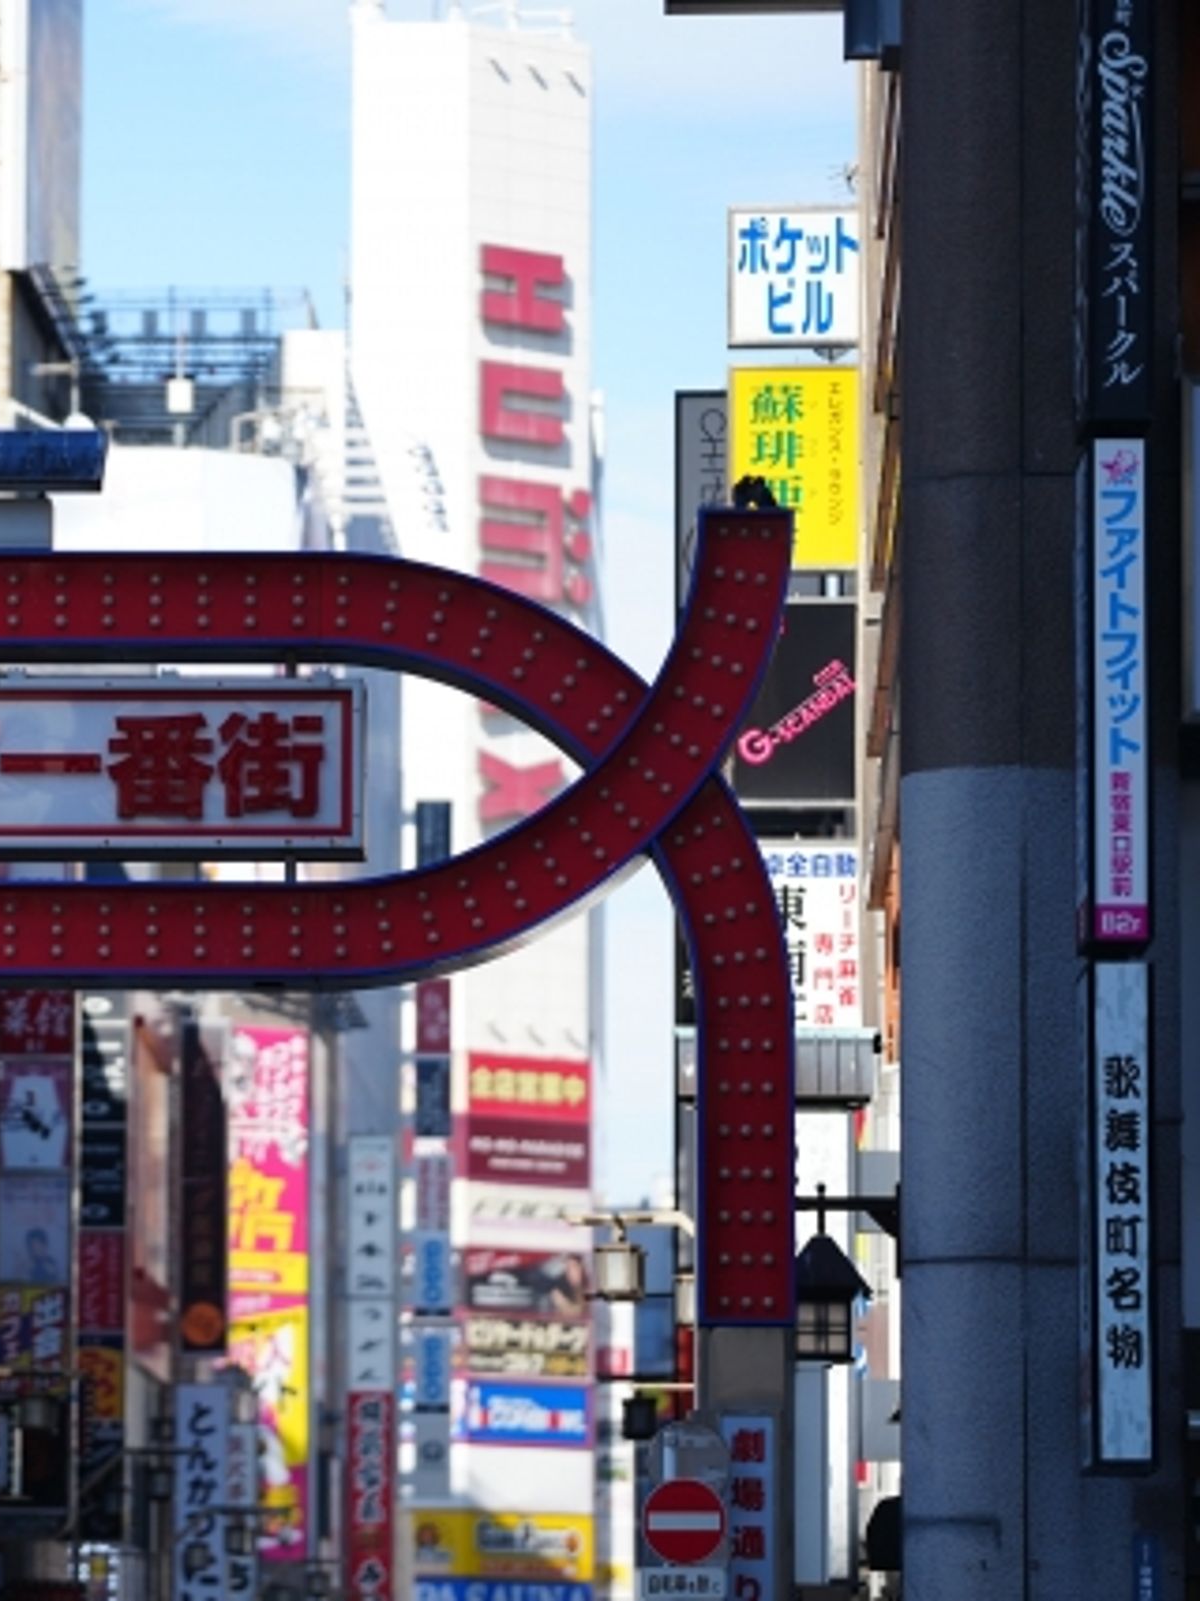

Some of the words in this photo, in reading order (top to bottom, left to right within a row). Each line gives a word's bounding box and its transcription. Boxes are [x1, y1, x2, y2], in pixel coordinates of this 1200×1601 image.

[1098, 31, 1148, 235] Sparkle
[737, 216, 860, 275] ポケット
[767, 277, 834, 335] ビル
[1103, 242, 1139, 389] スパークル
[478, 243, 566, 826] HUMX
[1100, 490, 1141, 766] ファイトフィット
[1110, 771, 1133, 898] 新宿東口駅前
[813, 933, 834, 1025] 専門店
[839, 883, 857, 1007] リーチ麻雀
[1103, 1055, 1143, 1371] 歌舞伎町名物
[731, 1428, 766, 1601] 劇場通り
